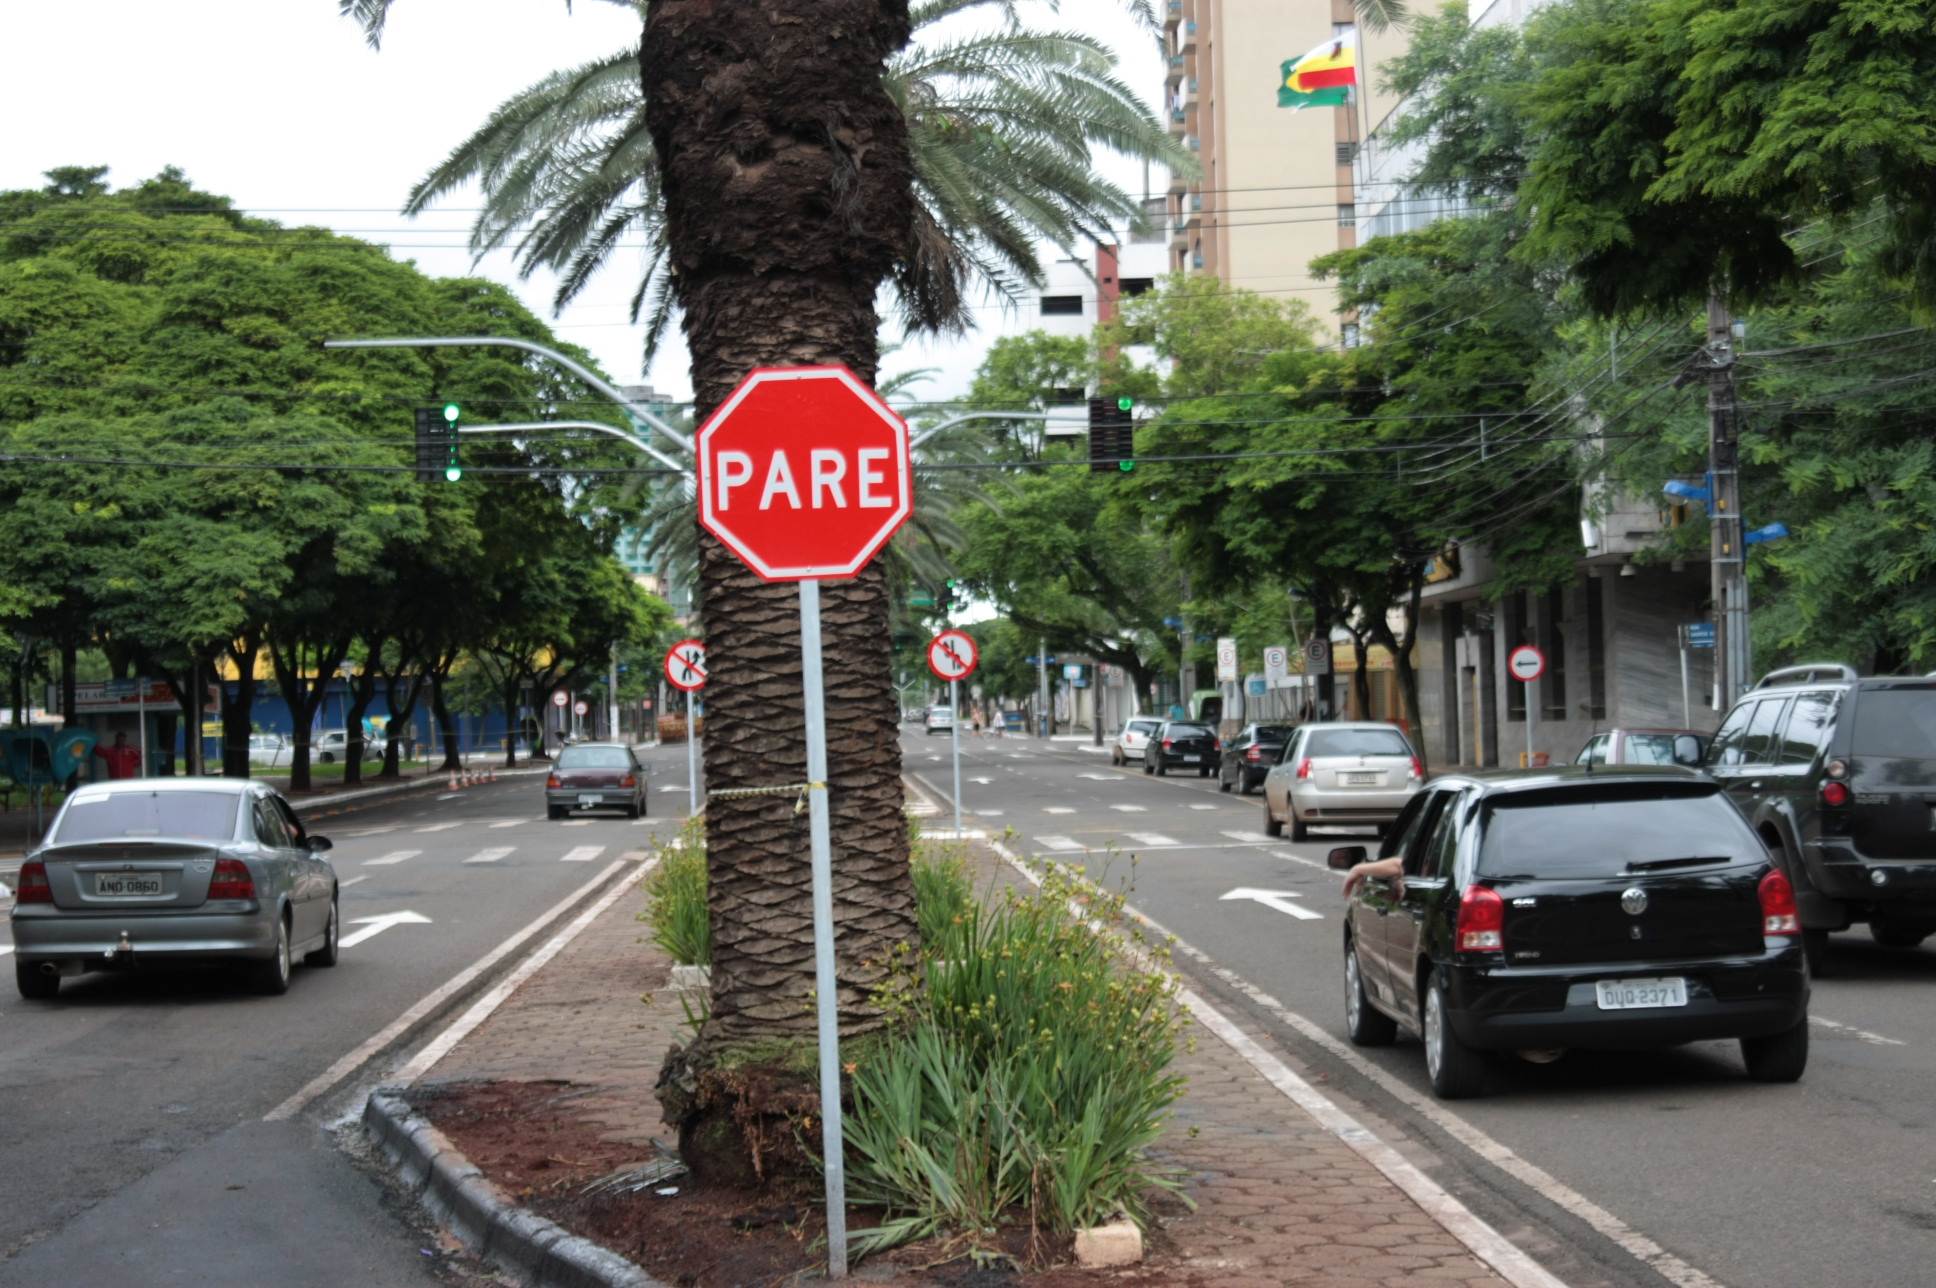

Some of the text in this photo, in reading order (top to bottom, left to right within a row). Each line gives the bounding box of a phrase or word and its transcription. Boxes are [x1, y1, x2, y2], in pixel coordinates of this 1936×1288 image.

[717, 448, 892, 511] PARE
[1224, 651, 1231, 660] E
[1312, 645, 1321, 656] E
[1271, 653, 1280, 663] E
